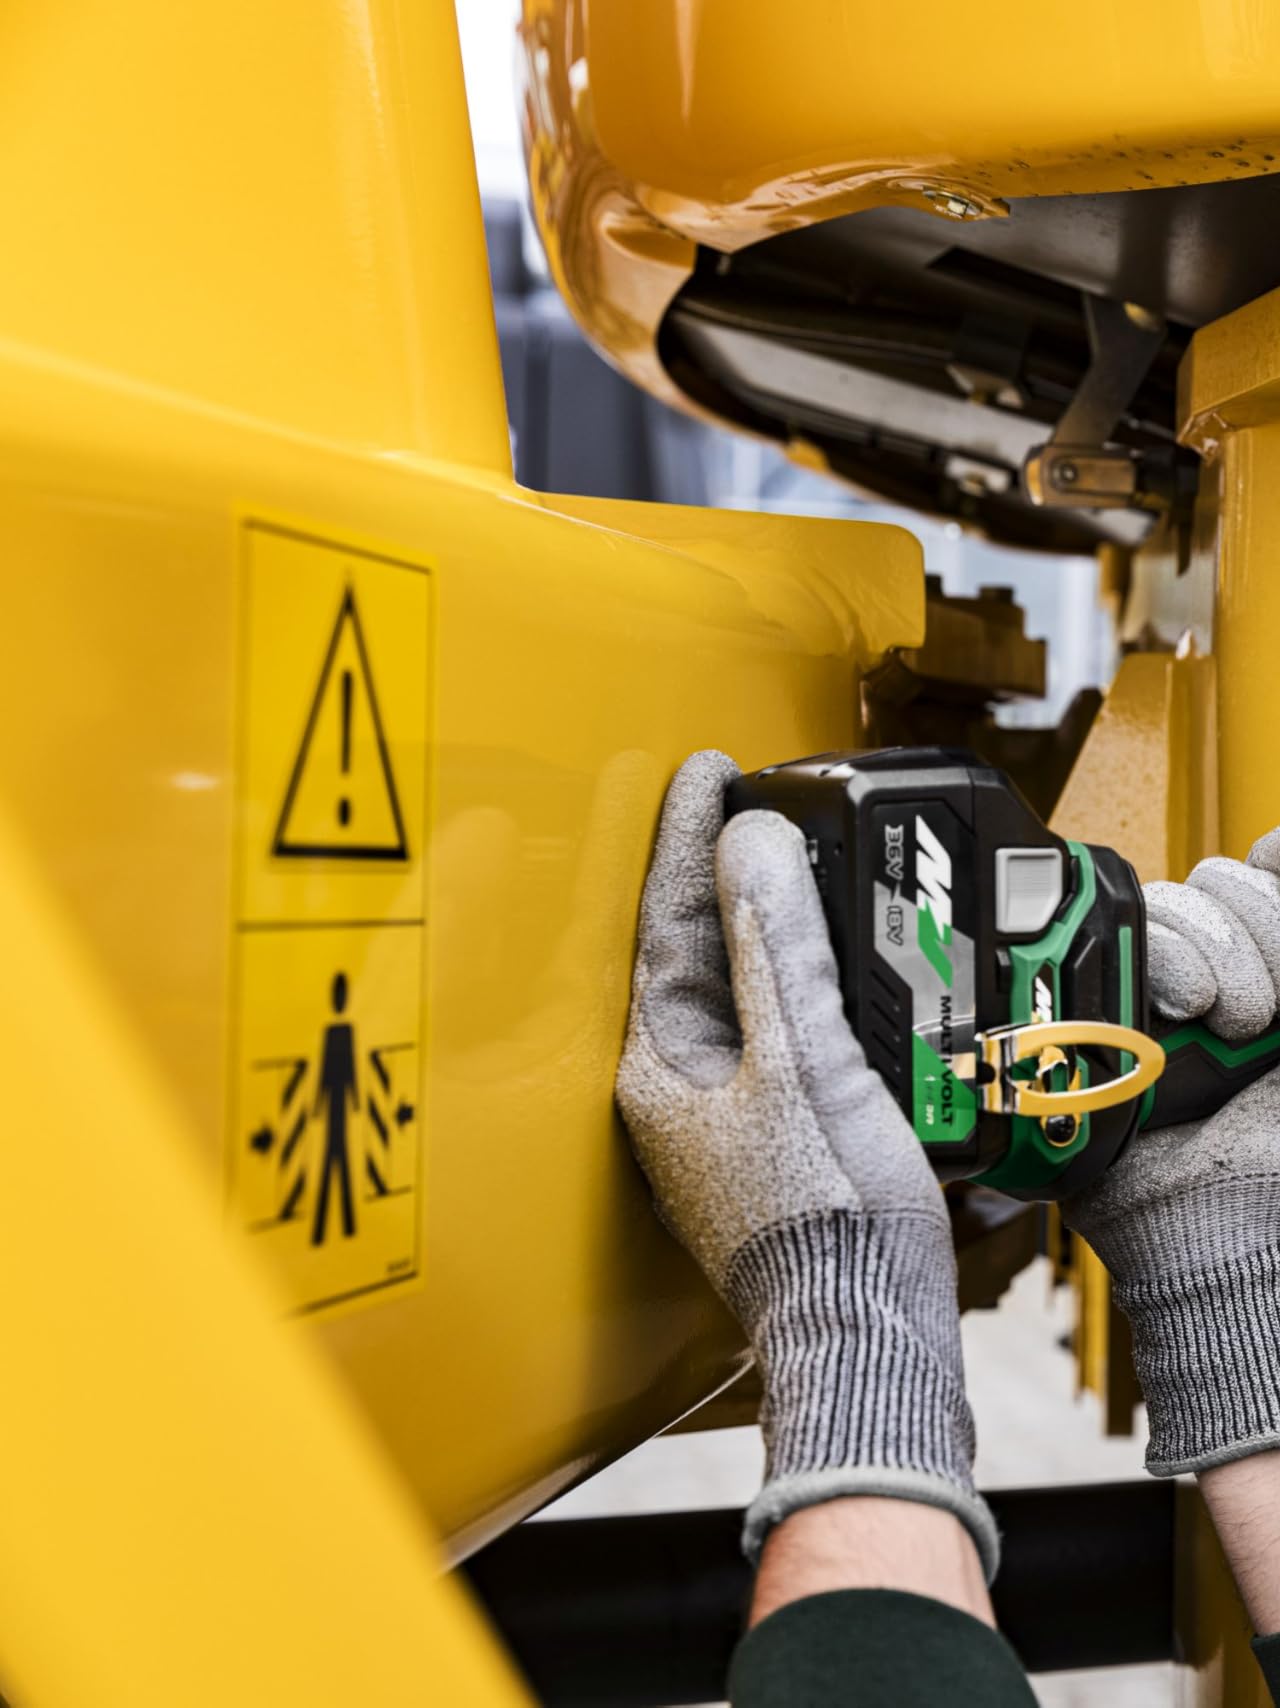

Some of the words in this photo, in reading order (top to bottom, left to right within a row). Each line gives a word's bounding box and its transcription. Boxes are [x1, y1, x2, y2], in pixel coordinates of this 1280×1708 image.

[885, 824, 904, 880] 36V
[886, 905, 903, 946] 18V
[940, 995, 953, 1066] MULTI
[940, 1068, 953, 1127] VOLT
